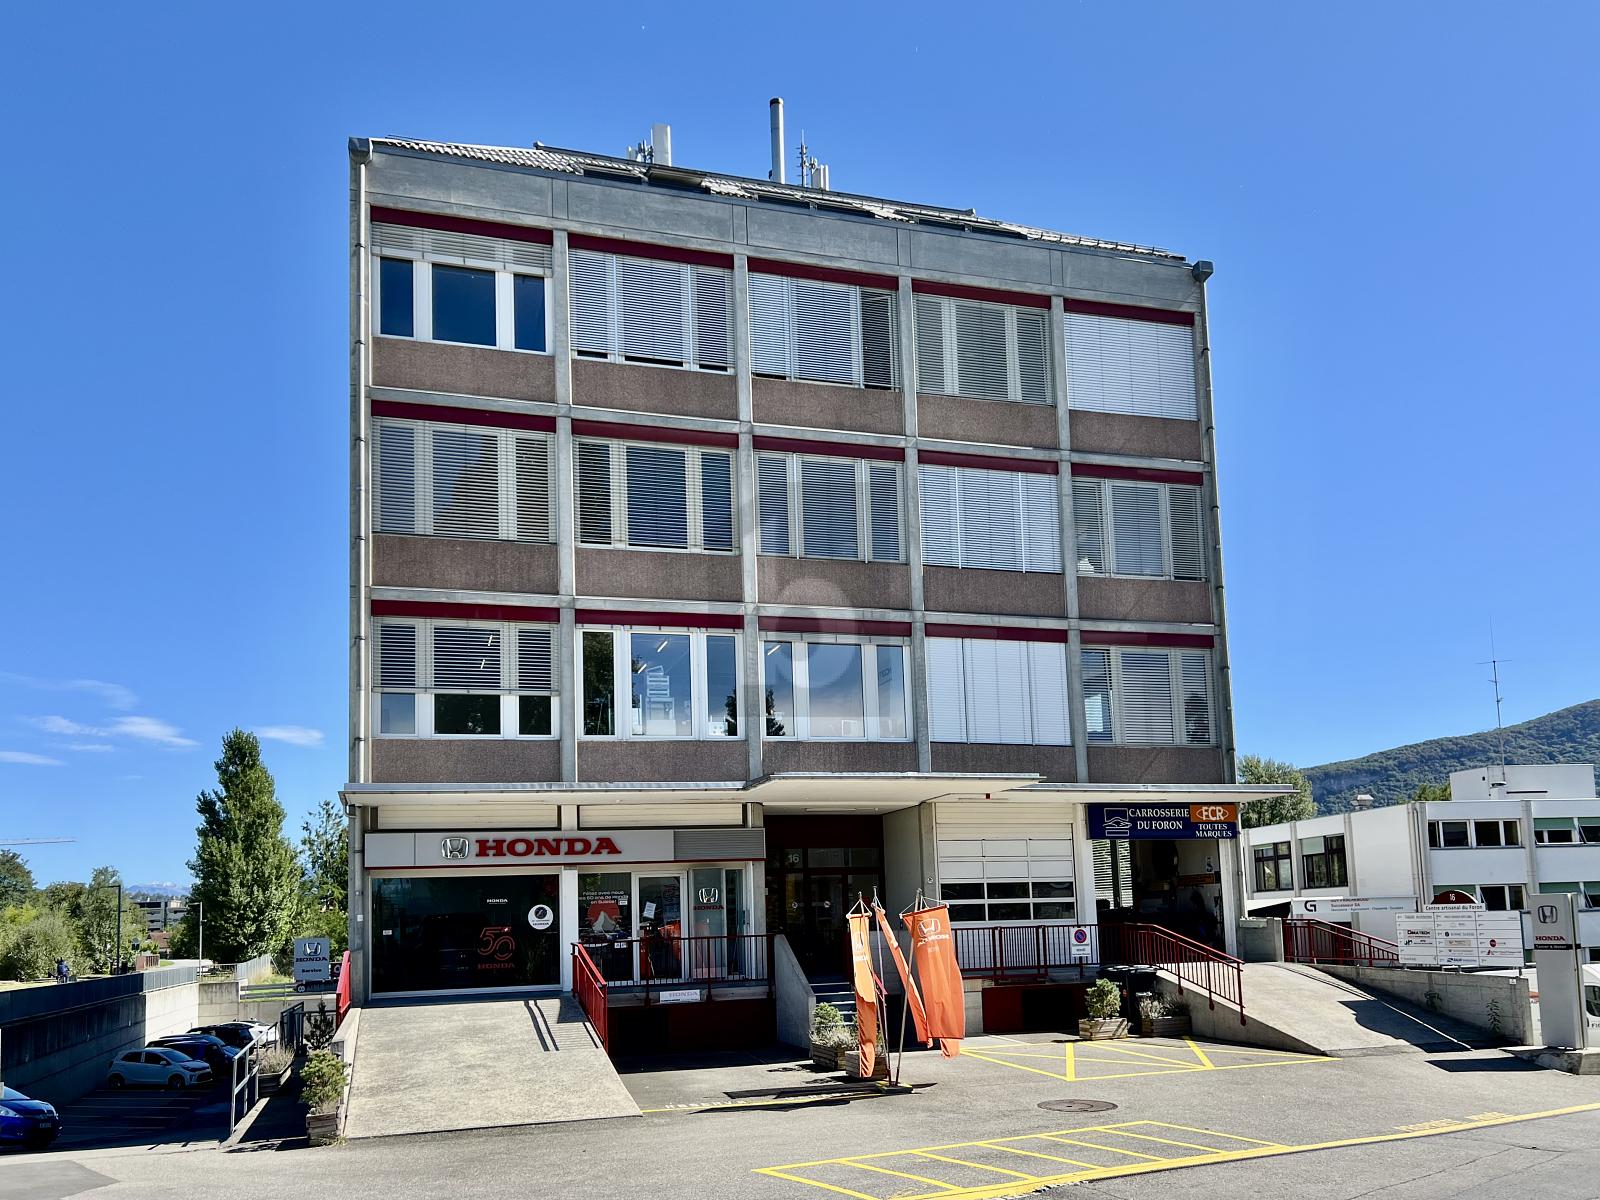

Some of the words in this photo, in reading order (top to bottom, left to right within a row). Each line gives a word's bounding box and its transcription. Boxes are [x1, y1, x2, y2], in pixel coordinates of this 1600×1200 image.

[1128, 808, 1190, 818] CARROSSERIE
[1137, 820, 1151, 830] DU
[1152, 820, 1183, 830] FORON
[1197, 823, 1228, 831] TOUTES
[1195, 830, 1232, 839] MARQUES
[475, 837, 622, 857] HONDA
[788, 853, 800, 863] 16
[1449, 893, 1456, 901] 16
[478, 962, 515, 970] HONDA
